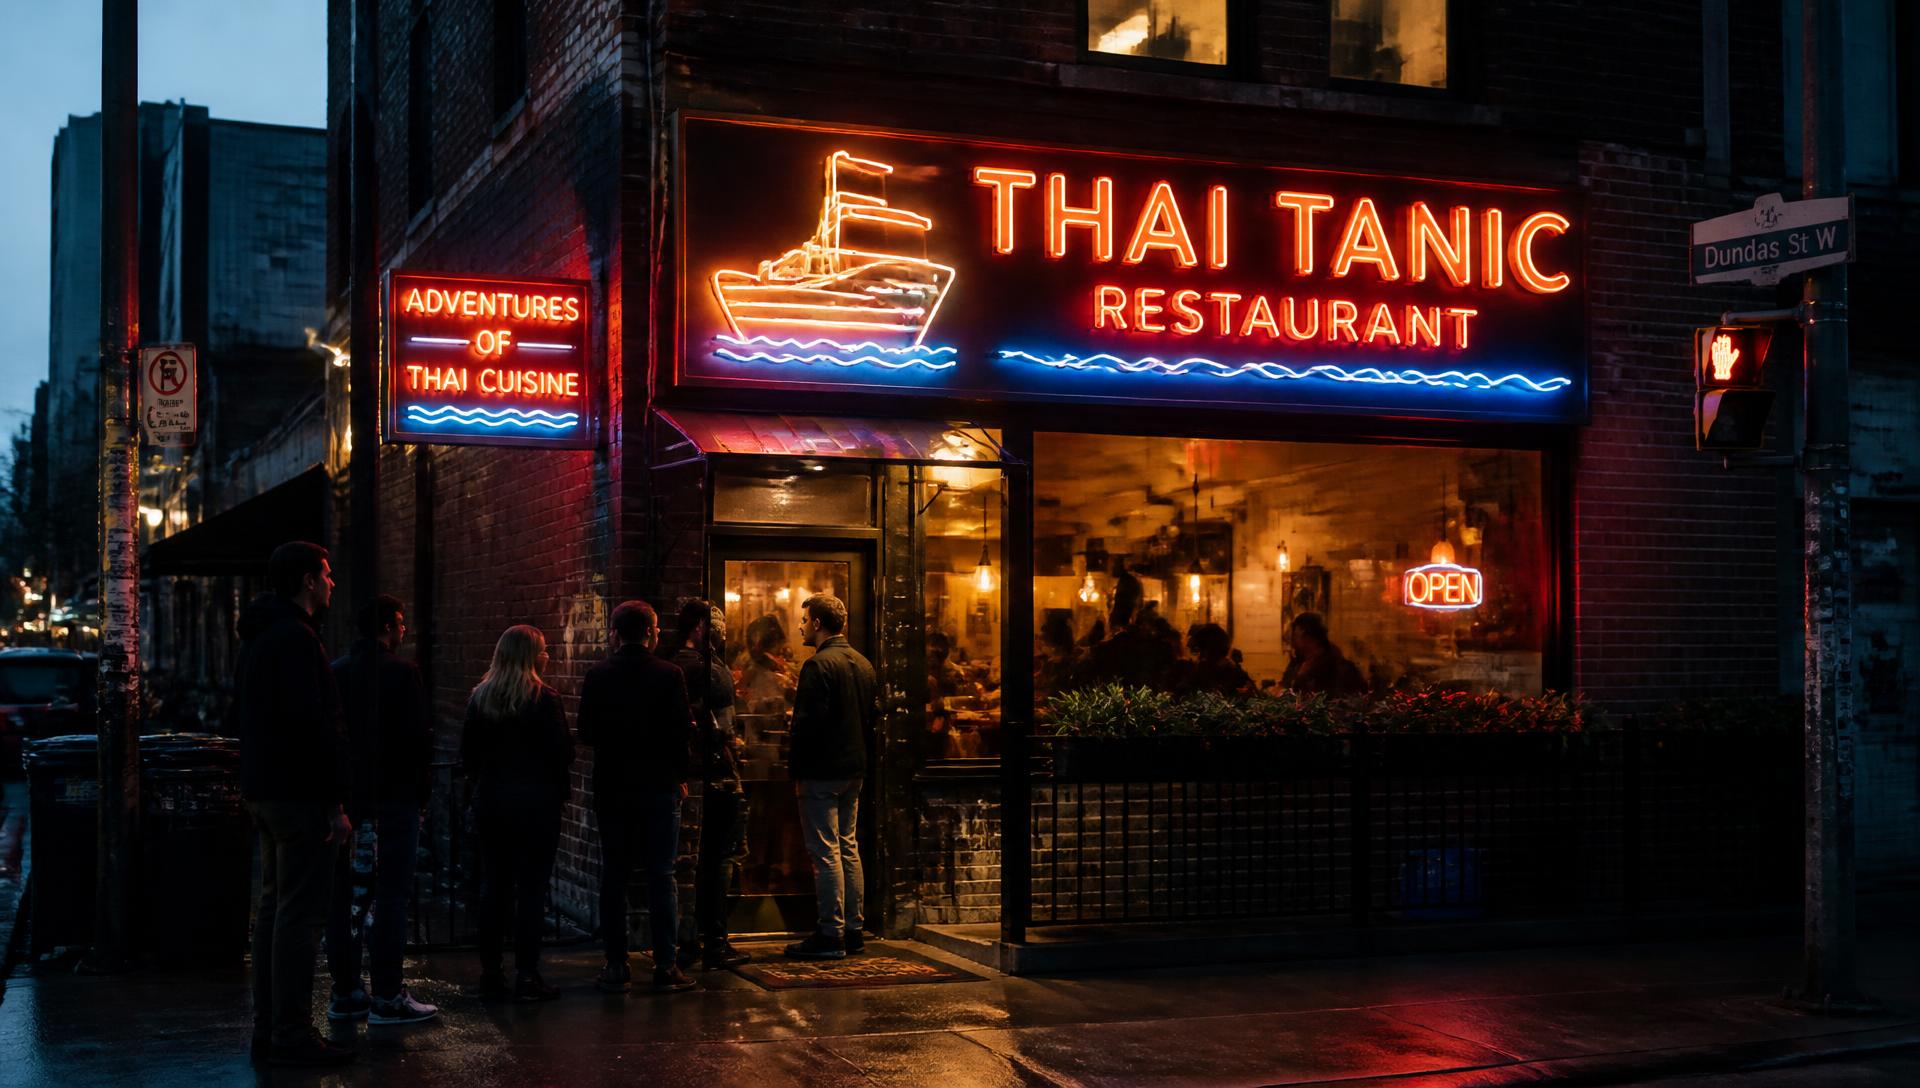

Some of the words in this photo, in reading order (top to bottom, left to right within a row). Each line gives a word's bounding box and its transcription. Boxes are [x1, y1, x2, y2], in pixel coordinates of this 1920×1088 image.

[974, 166, 1228, 269] THAI
[1276, 191, 1570, 294] TANIC
[1705, 239, 1780, 269] Dundas
[1788, 233, 1809, 255] St
[1816, 226, 1836, 250] W
[406, 288, 579, 321] ADVENTURES
[1094, 285, 1478, 349] RESTAURANT
[476, 329, 511, 355] OF
[407, 365, 467, 391] THAI
[480, 368, 579, 396] CUISINE
[1409, 572, 1479, 603] OPEN
